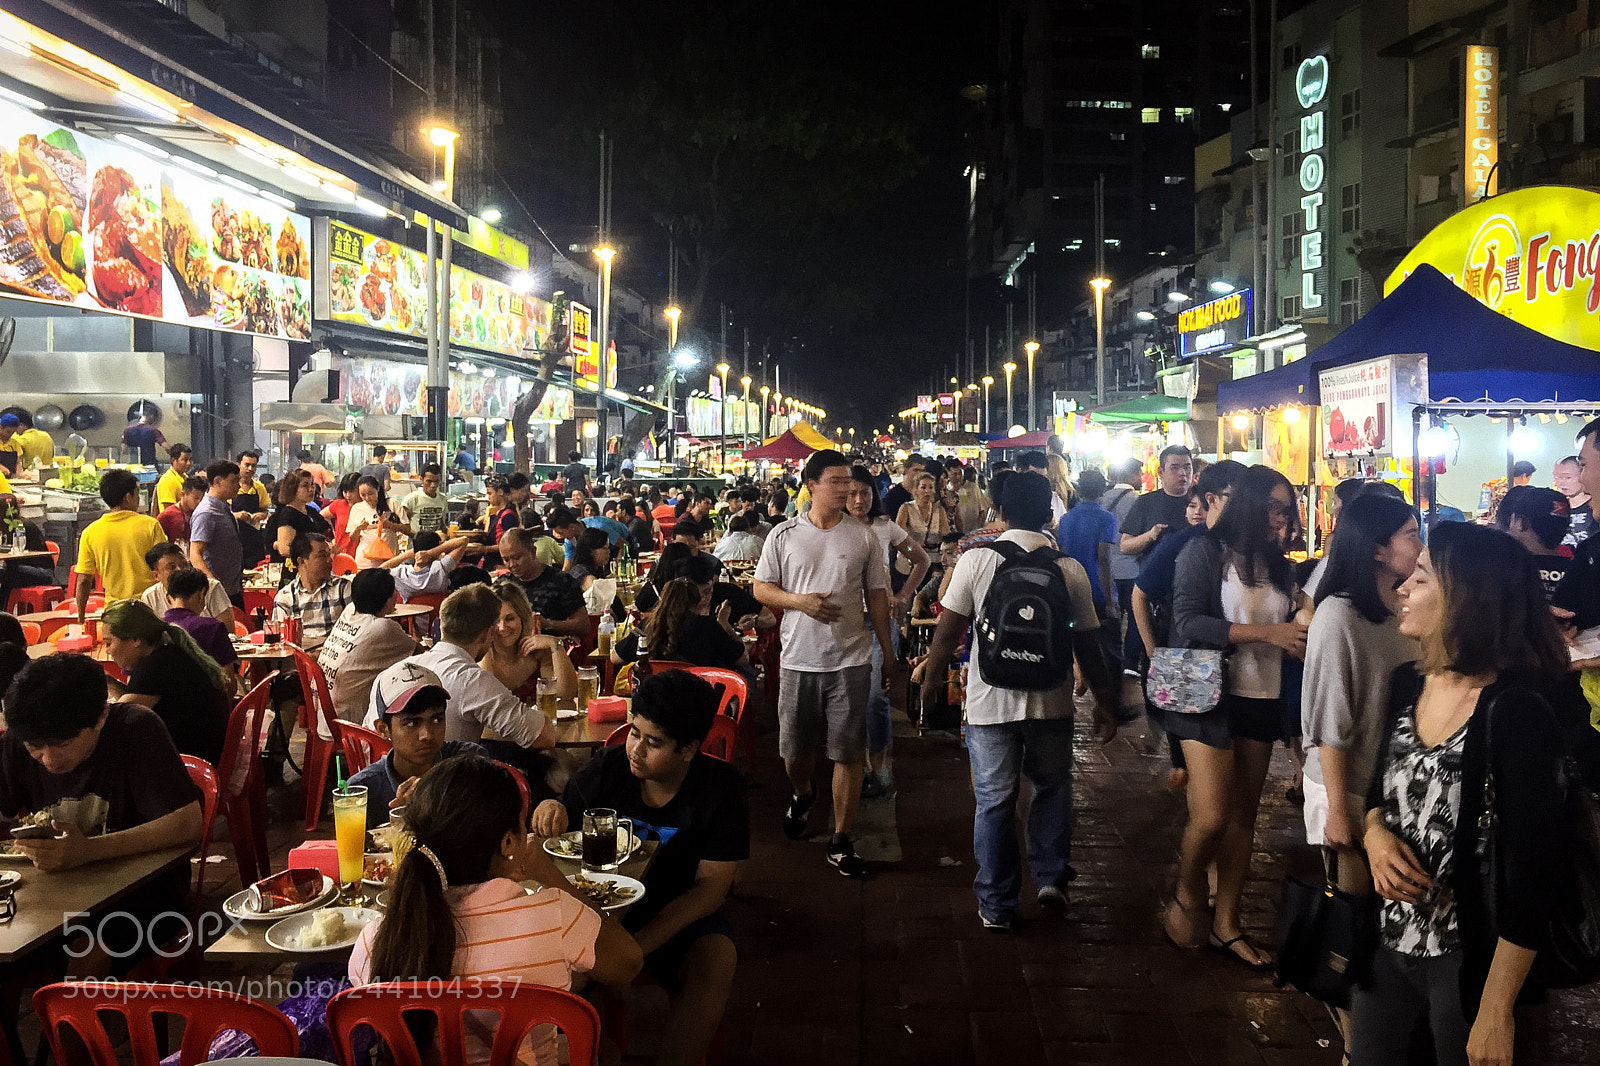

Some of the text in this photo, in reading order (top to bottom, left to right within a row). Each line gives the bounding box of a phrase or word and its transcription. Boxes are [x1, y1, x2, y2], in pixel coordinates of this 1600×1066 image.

[1474, 53, 1492, 130] HOTEL
[1300, 111, 1324, 309] HOTEL
[1214, 294, 1241, 324] FOOD
[1337, 386, 1371, 401] POMEGRANATE
[1373, 383, 1388, 396] JUICE
[1001, 648, 1044, 663] deuter
